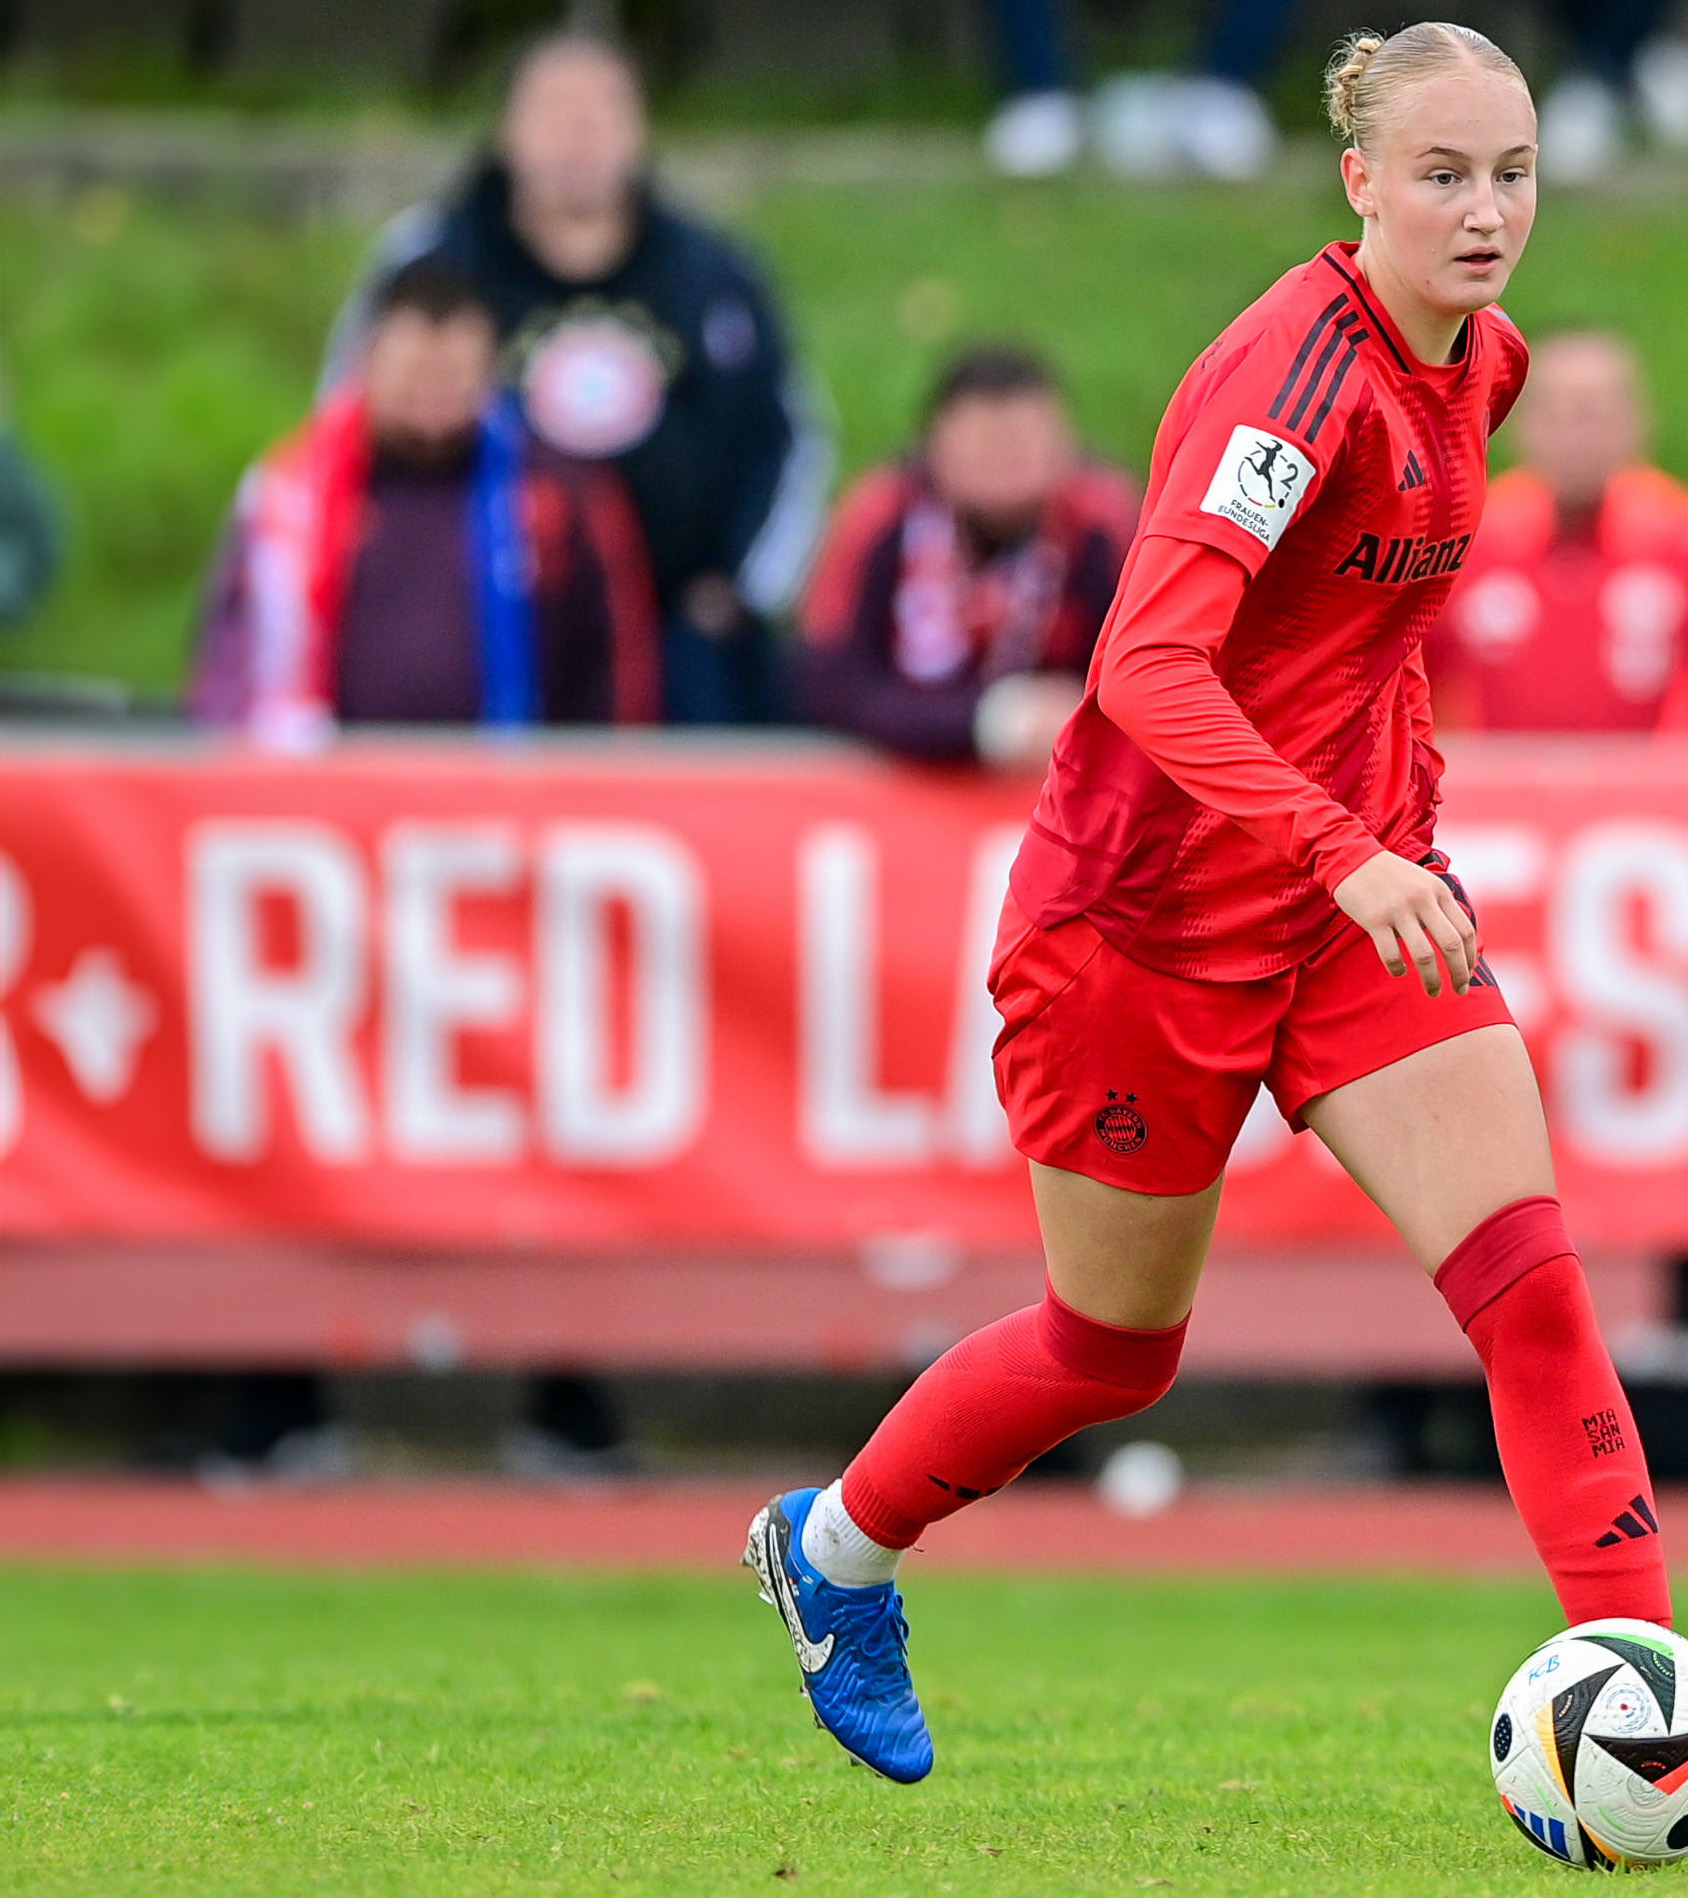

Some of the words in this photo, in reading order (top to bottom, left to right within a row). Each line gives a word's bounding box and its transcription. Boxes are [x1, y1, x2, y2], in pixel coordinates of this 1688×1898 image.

[1279, 462, 1299, 491] 2
[1333, 532, 1472, 584] Allianz
[186, 818, 709, 1167] RED
[1582, 1408, 1617, 1432] MIA
[1587, 1421, 1621, 1444] SAN
[1592, 1436, 1626, 1458] MIA
